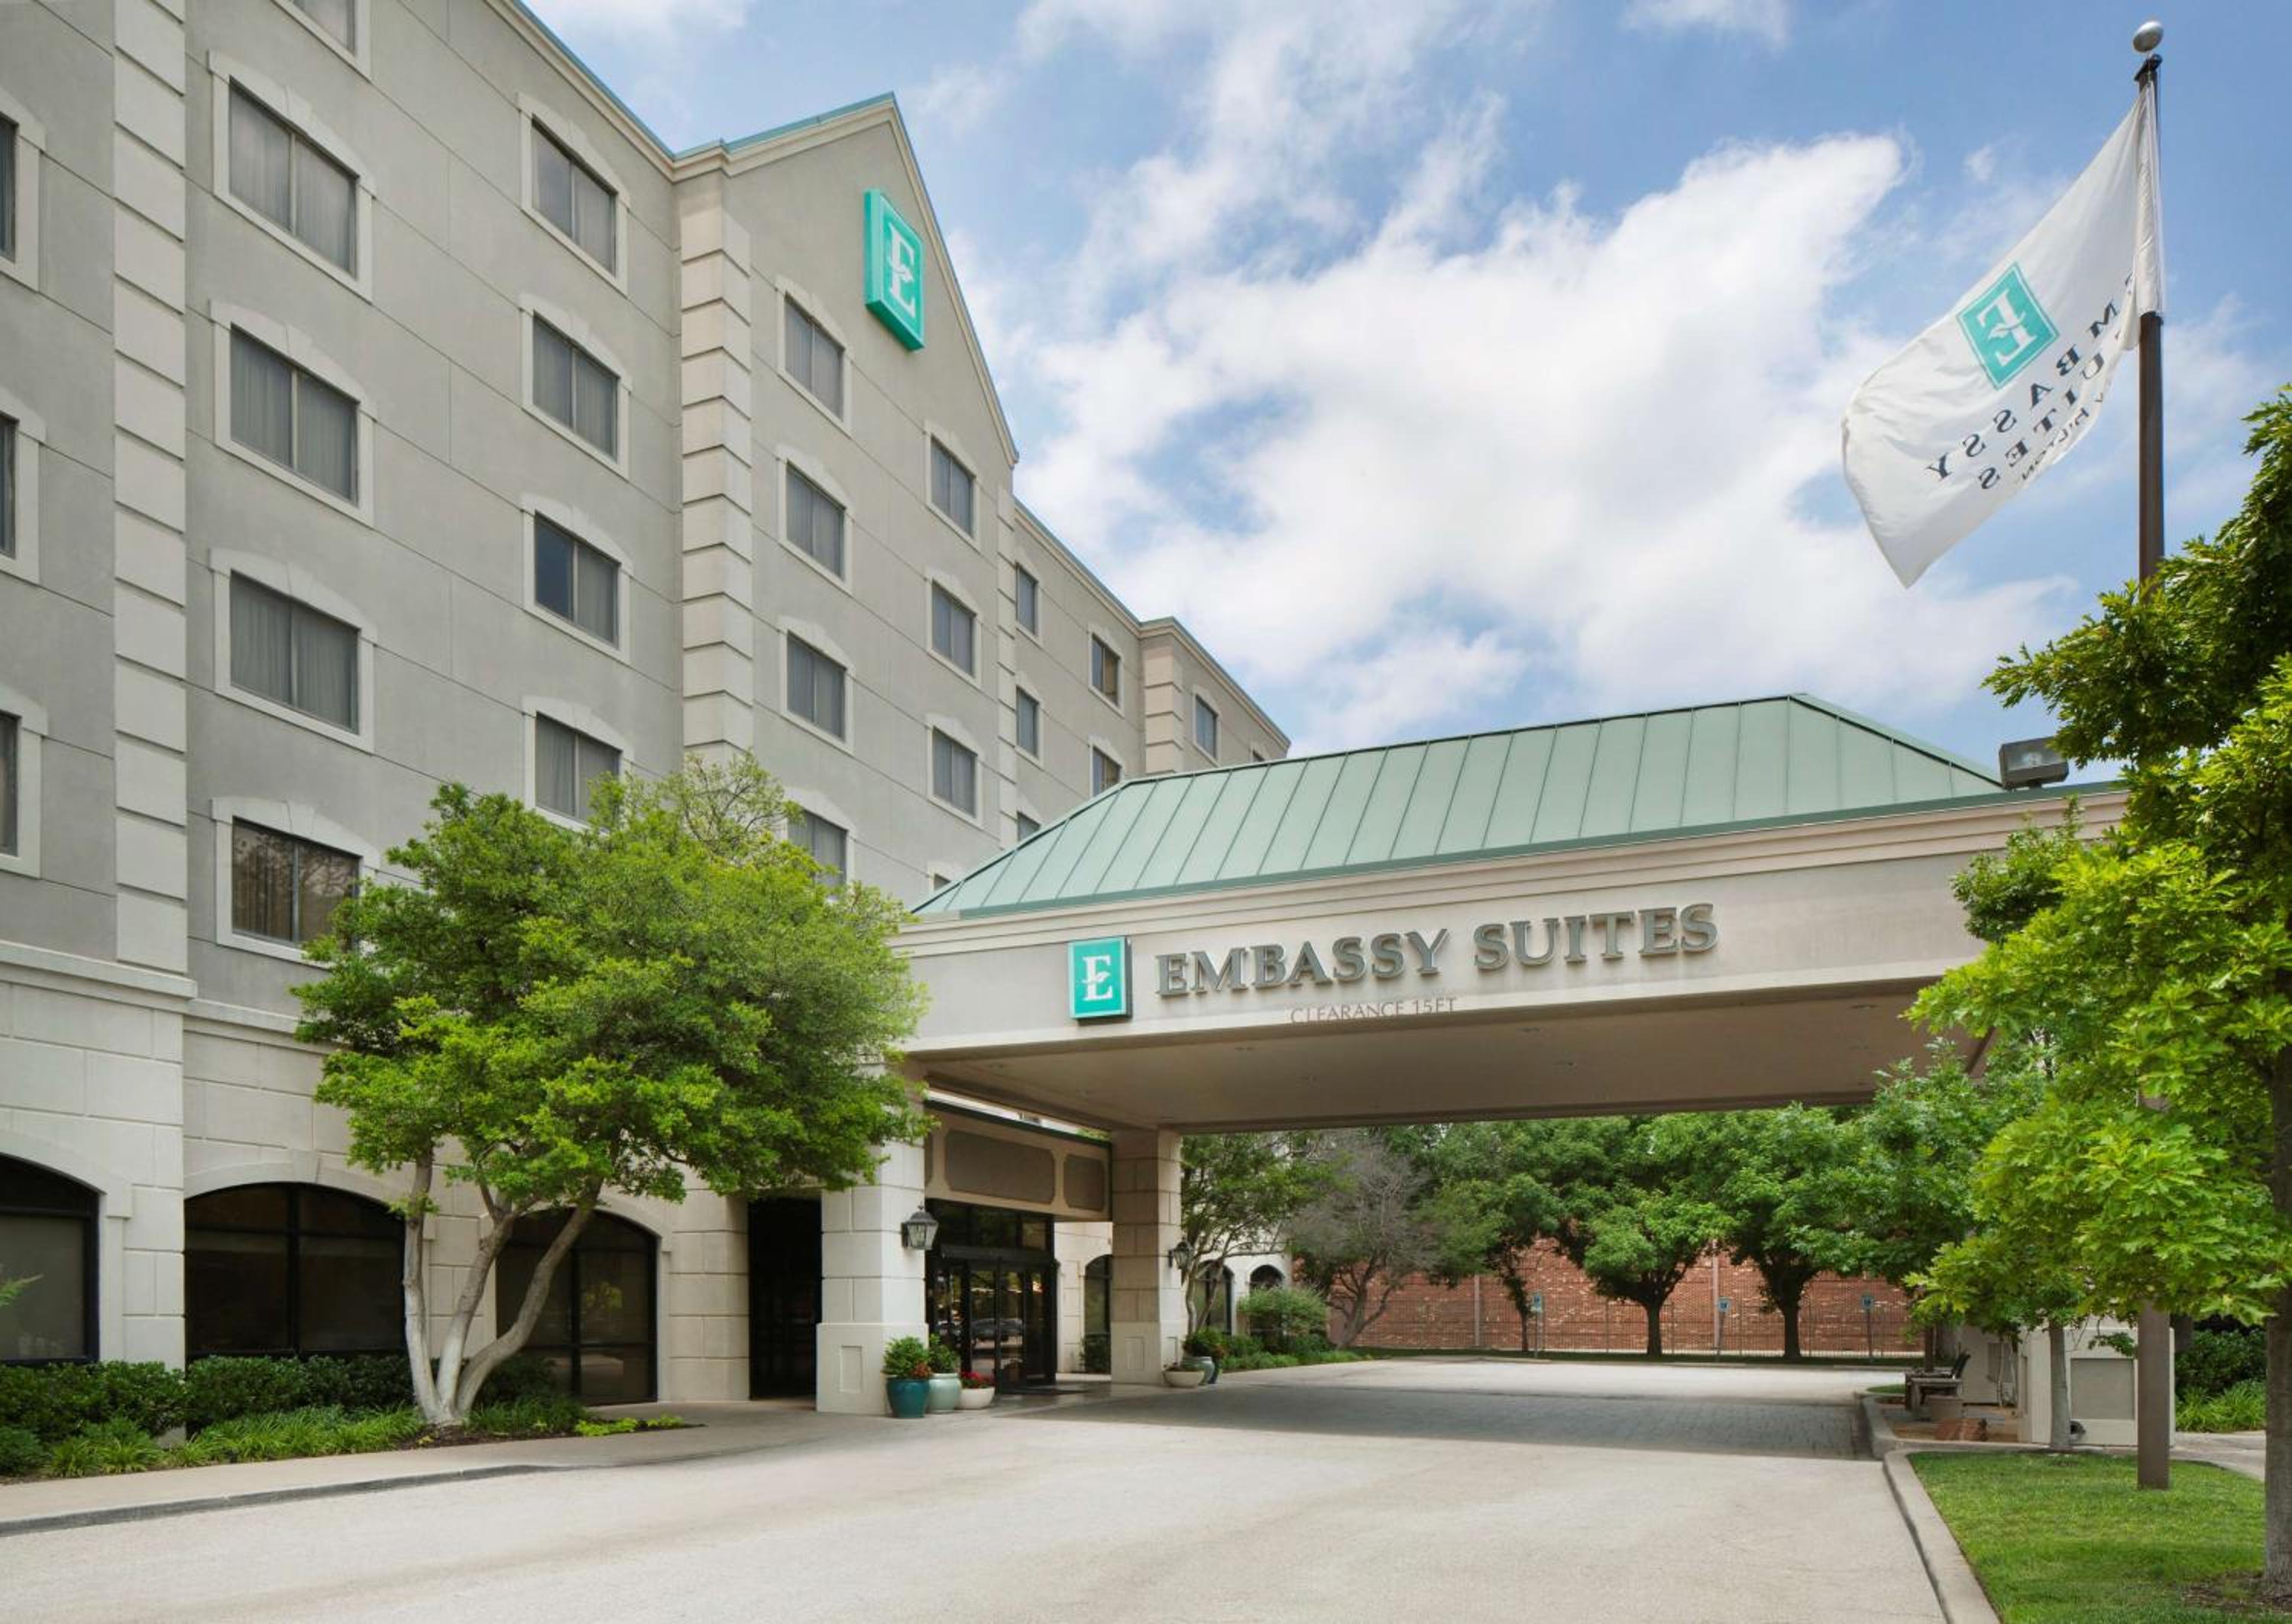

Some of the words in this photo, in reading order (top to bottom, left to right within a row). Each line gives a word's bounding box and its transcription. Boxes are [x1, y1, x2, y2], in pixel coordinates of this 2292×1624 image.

[888, 222, 915, 319] E
[1081, 954, 1114, 1002] E
[1154, 928, 1449, 996] EMBASSY
[1472, 903, 1718, 970] SUITES
[1290, 1001, 1404, 1024] CLEARANCE
[1412, 996, 1458, 1015] 15FT
